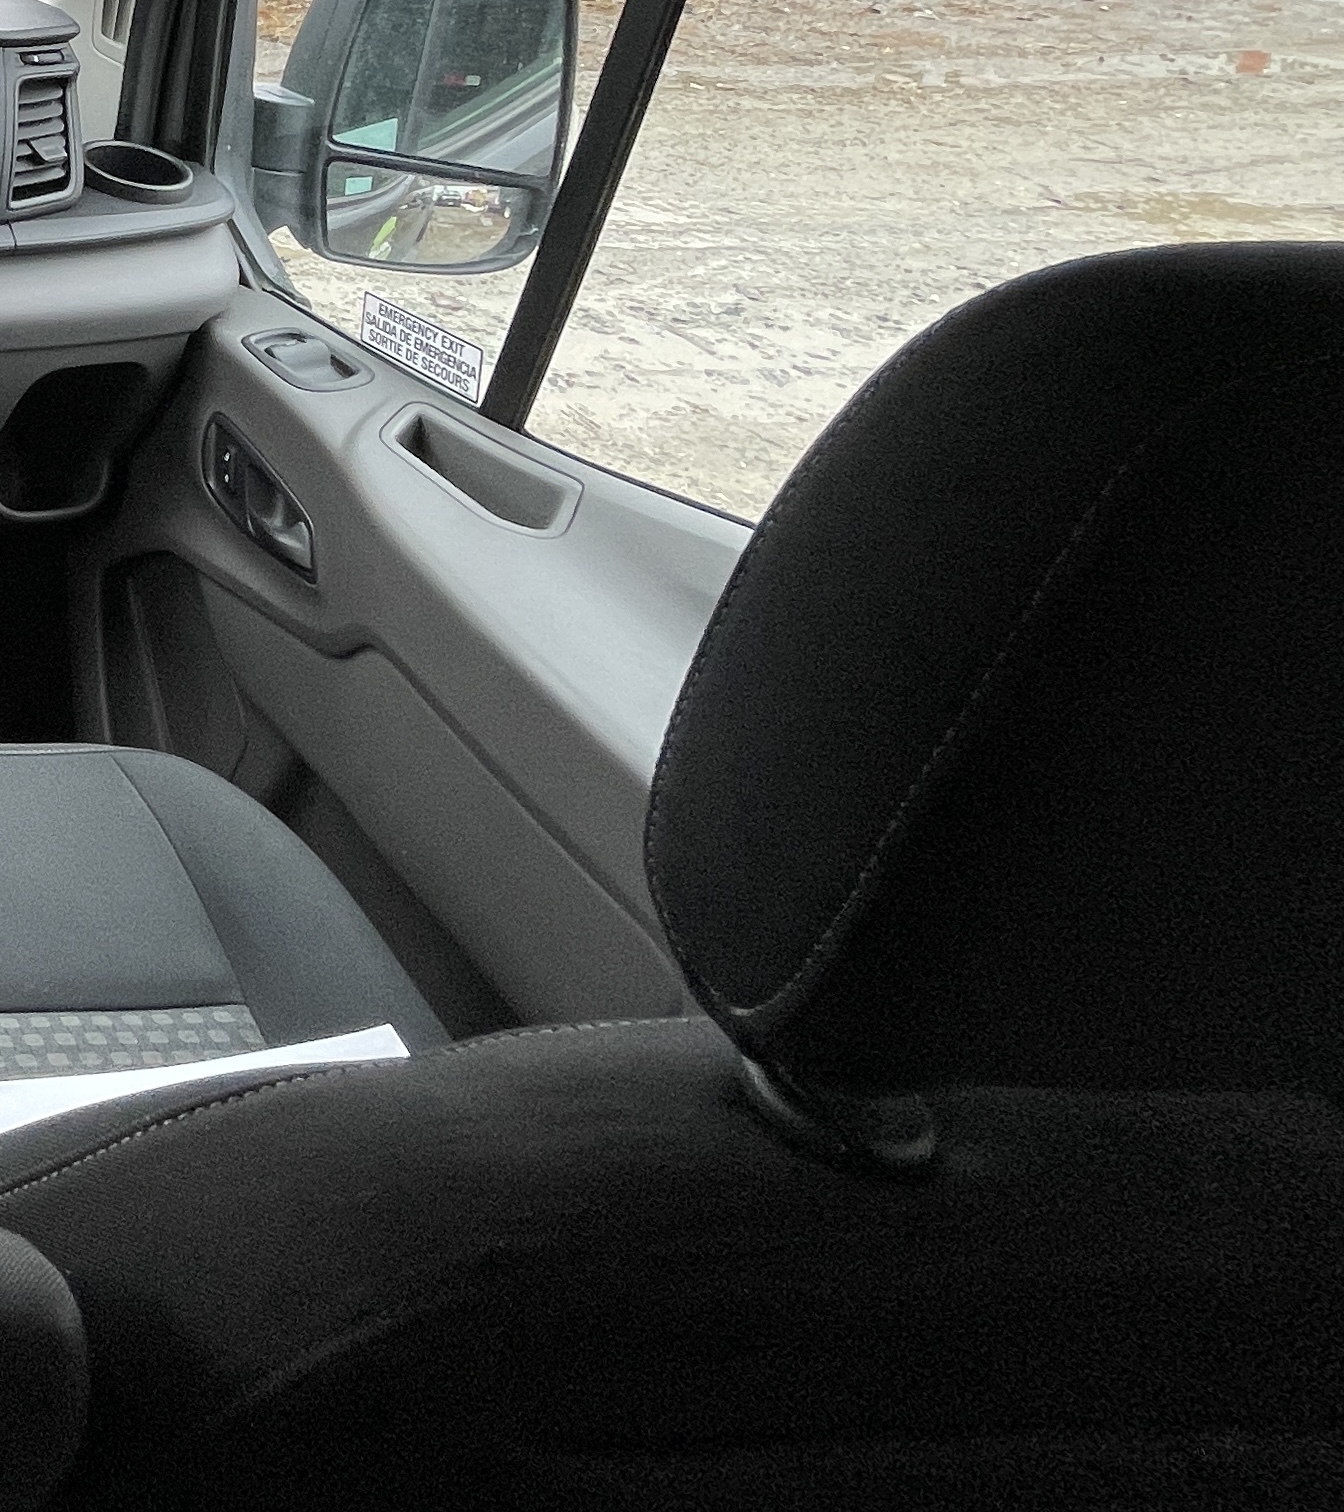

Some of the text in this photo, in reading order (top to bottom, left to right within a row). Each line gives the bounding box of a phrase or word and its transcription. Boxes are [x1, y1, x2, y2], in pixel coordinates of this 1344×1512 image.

[365, 312, 477, 381] SALIDA DE EMERGENCIA
[368, 329, 470, 392] SORTIE DE SECOURS
[378, 302, 466, 358] EMERGENCY EXIT
